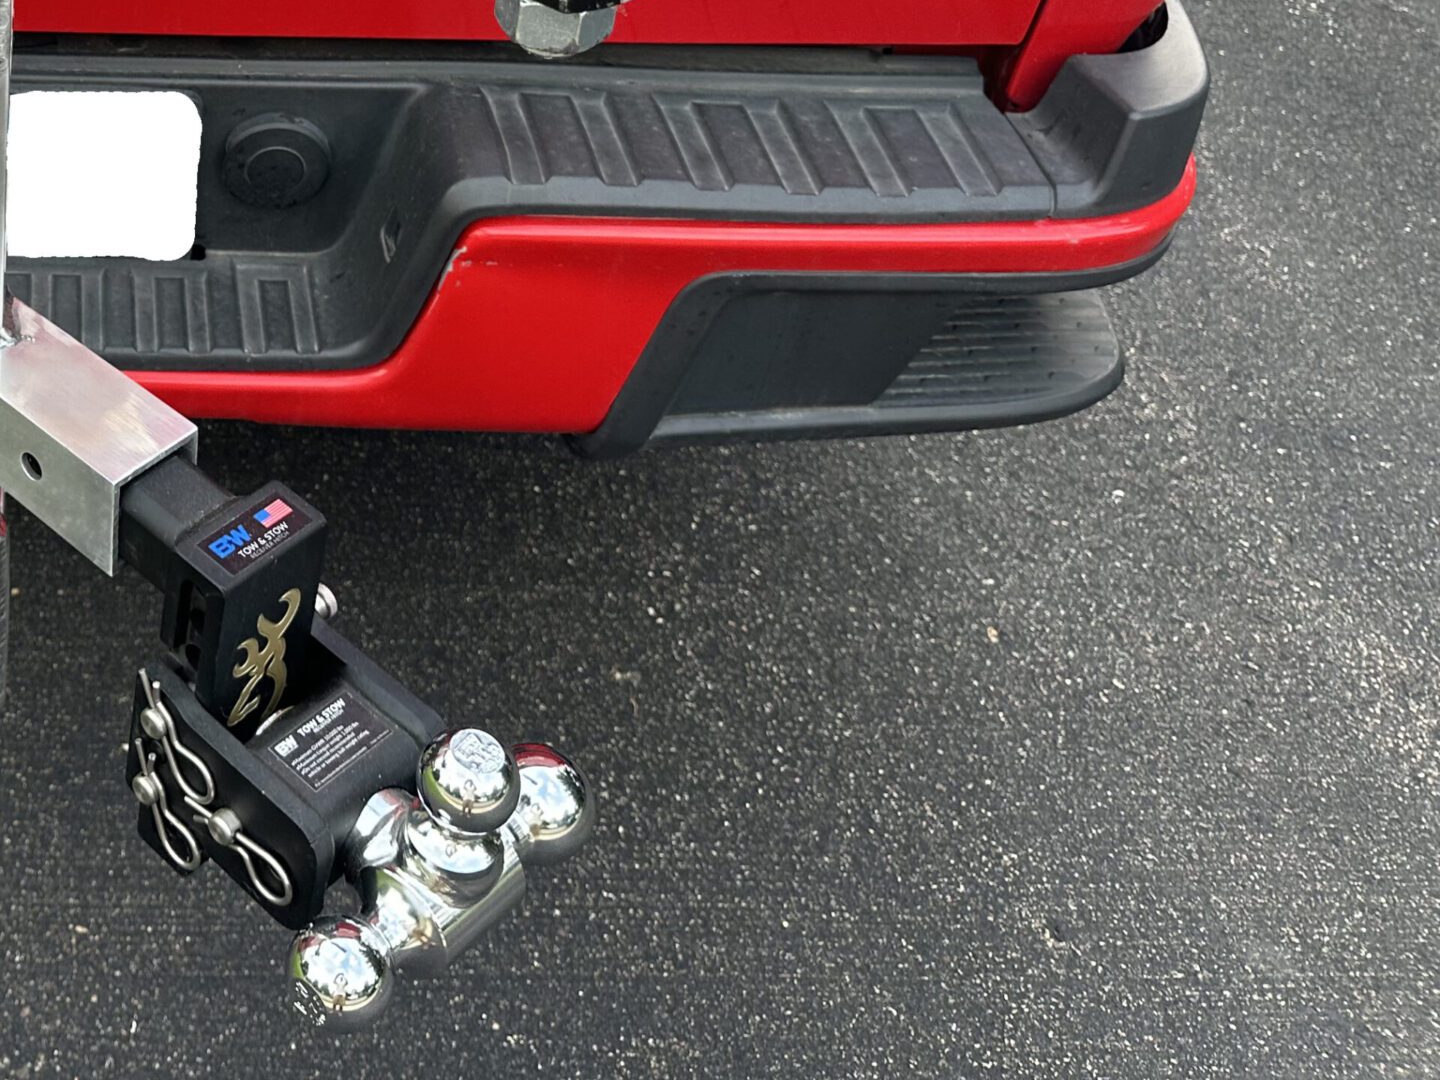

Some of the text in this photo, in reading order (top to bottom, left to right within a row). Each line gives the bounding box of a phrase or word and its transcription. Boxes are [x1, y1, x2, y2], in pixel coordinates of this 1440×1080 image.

[238, 521, 289, 557] TOW & STOW
[274, 530, 290, 544] HITCH
[297, 718, 318, 737] TOW
[322, 698, 346, 716] STOW
